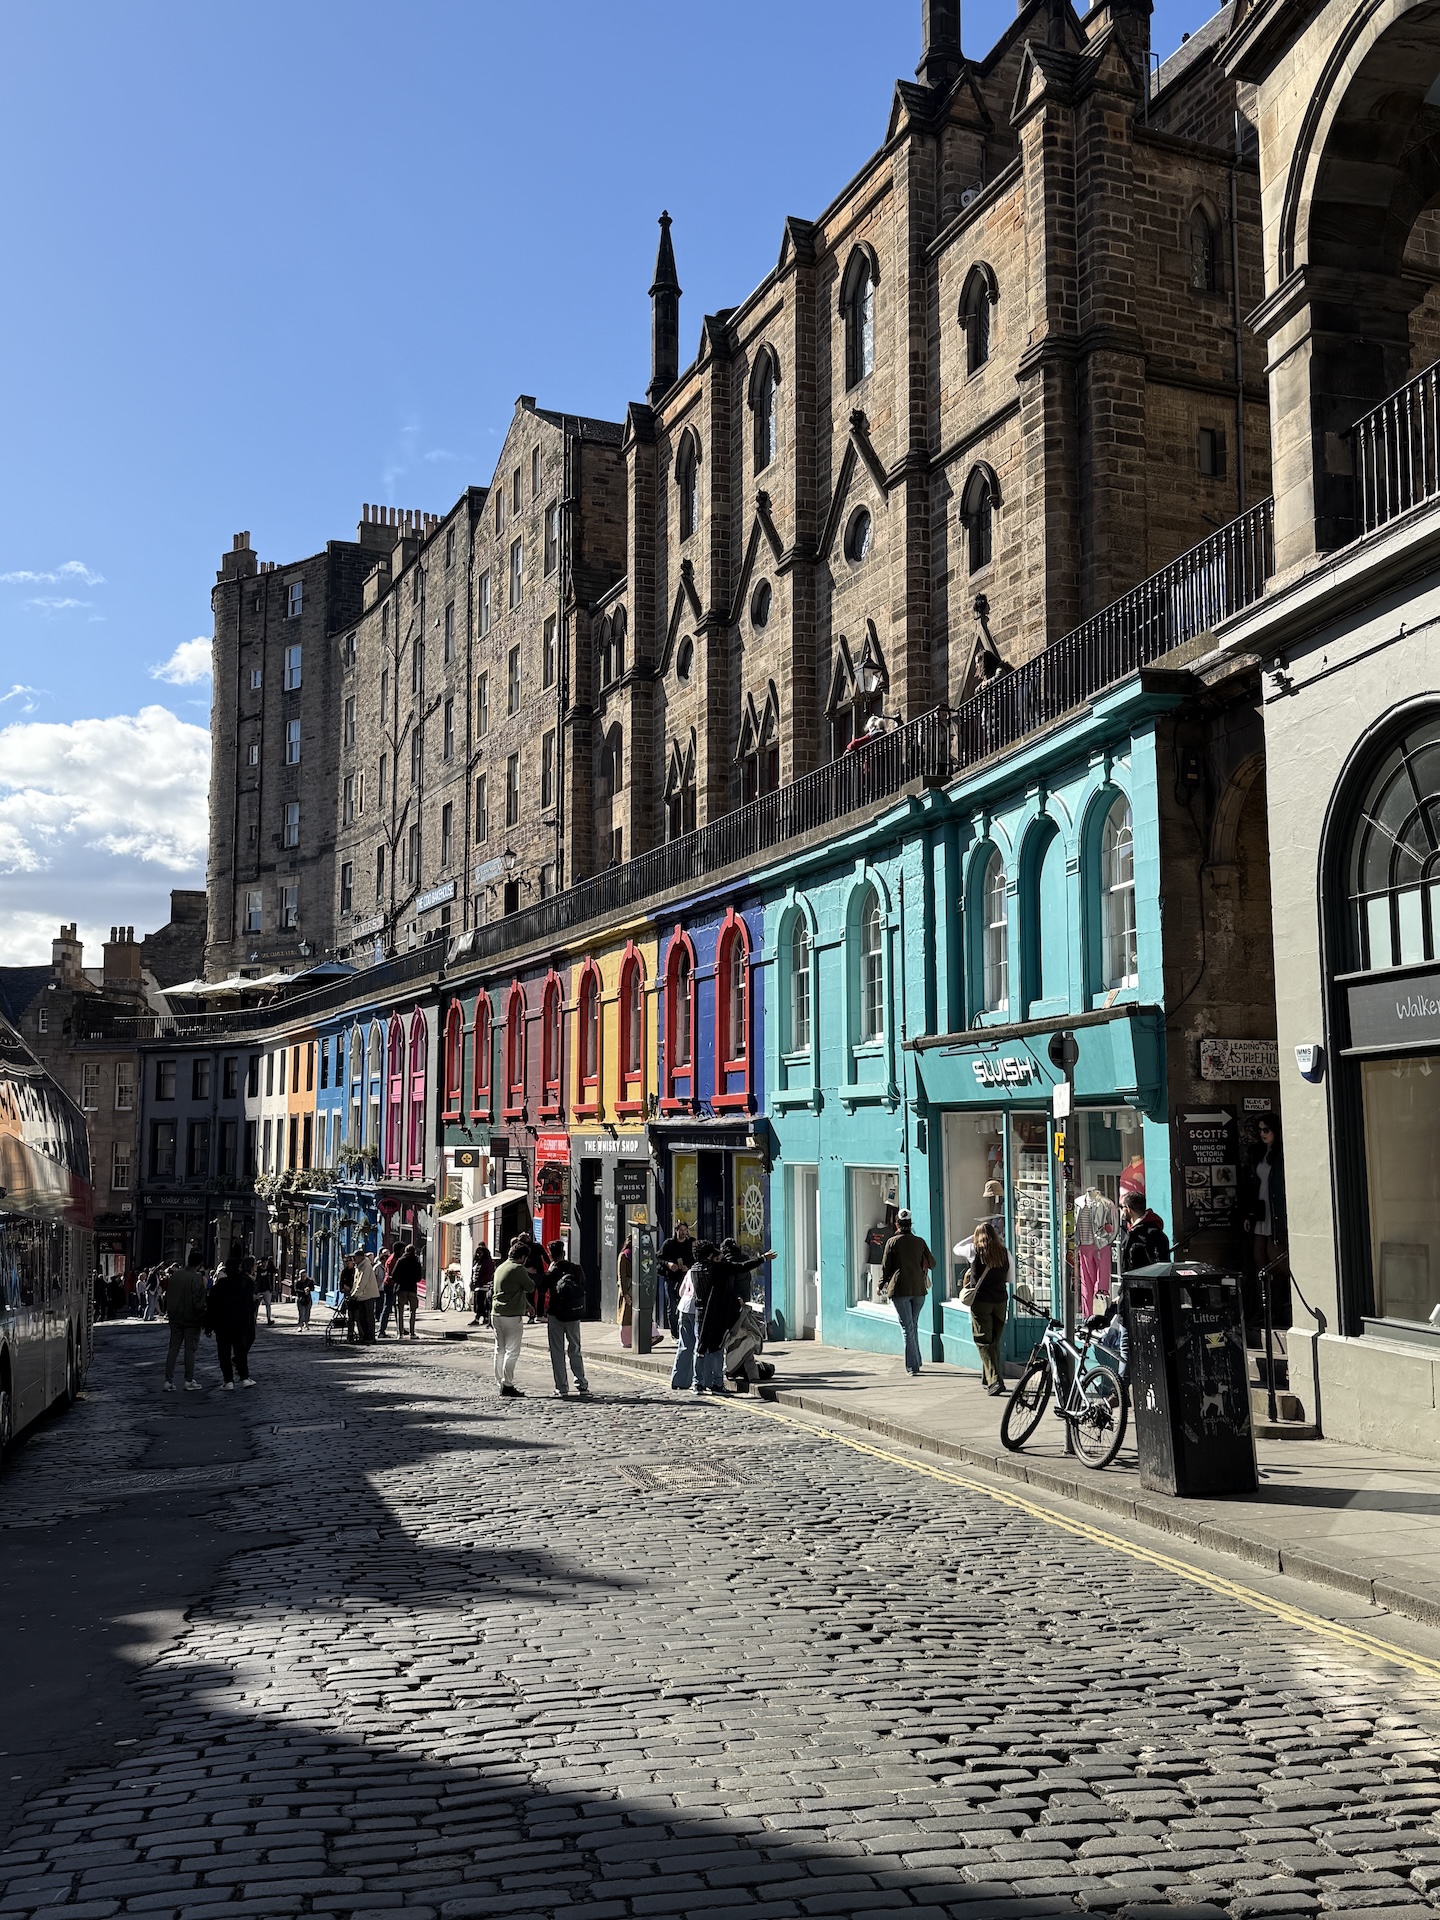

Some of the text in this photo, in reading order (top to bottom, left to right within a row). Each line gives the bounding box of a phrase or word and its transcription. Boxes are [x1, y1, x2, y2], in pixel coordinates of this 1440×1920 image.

[1230, 1043, 1259, 1051] LEADING
[1229, 1066, 1280, 1078] THE CAS
[1189, 1129, 1229, 1139] SCOTTS
[585, 1137, 639, 1153] THE WHISKY SHOP
[1195, 1150, 1224, 1158] VICTORIA
[1192, 1313, 1220, 1324] Litter
